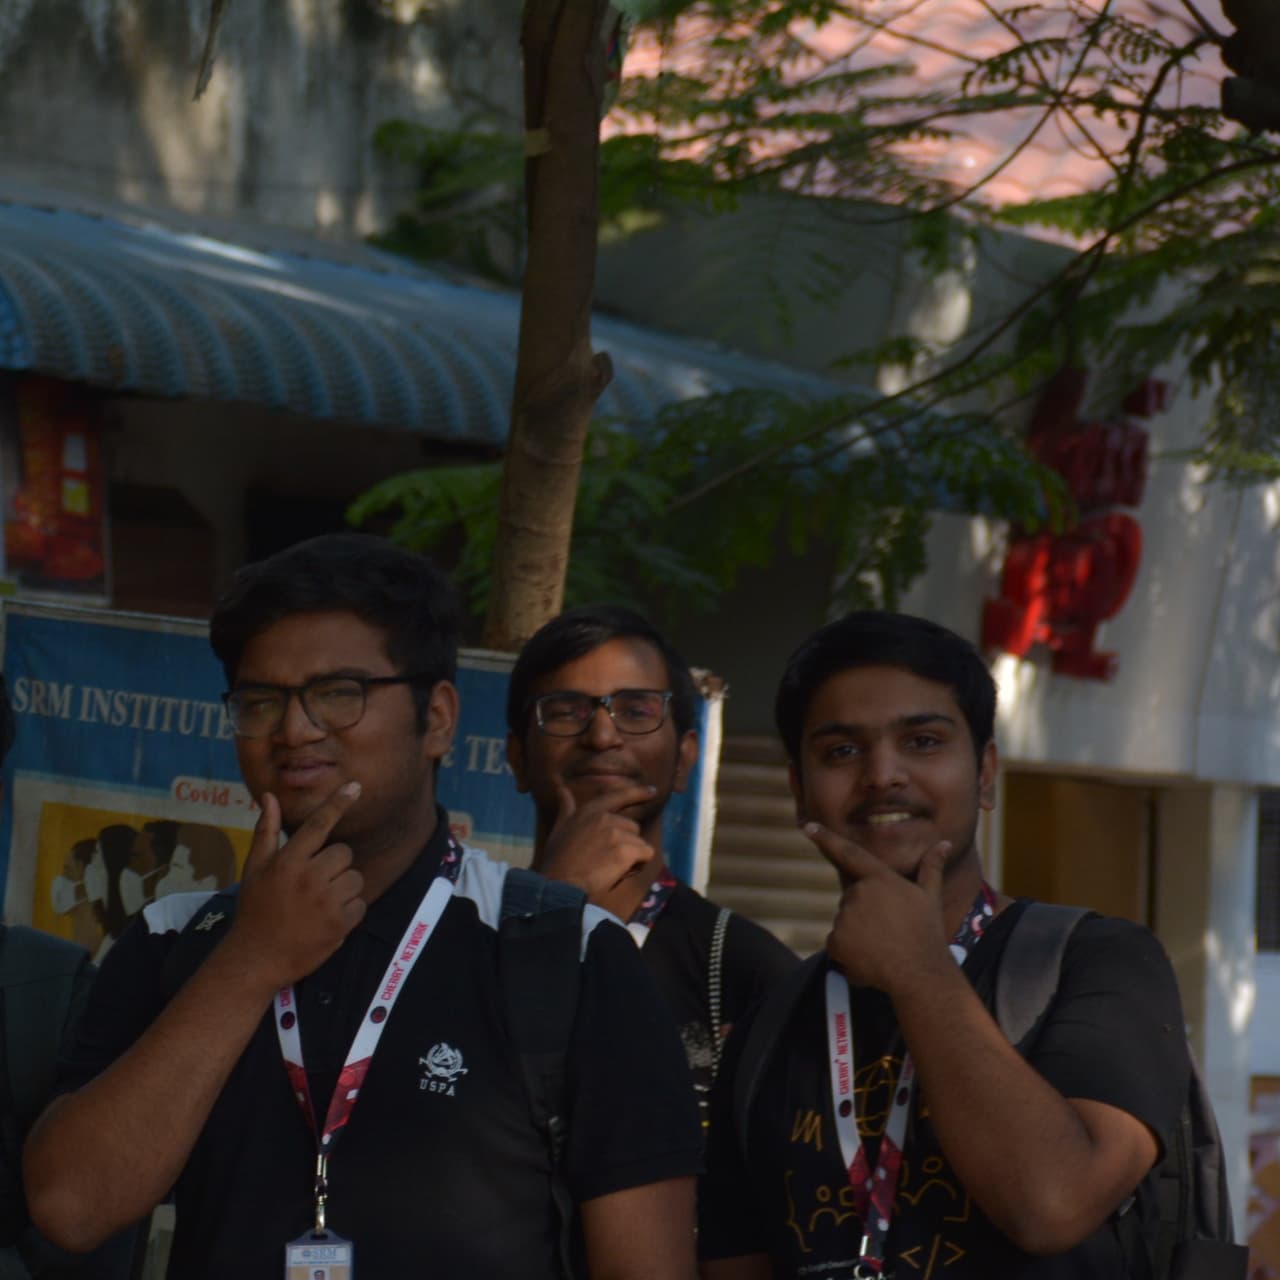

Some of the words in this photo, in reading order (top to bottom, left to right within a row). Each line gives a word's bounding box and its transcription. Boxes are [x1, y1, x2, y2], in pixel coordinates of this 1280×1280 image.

[13, 676, 74, 718] SRM
[79, 686, 237, 740] INSTITUTE
[176, 782, 229, 806] Covid
[400, 921, 429, 963] NETWORK
[834, 1012, 849, 1056] NETWORK
[418, 1077, 457, 1098] USPA
